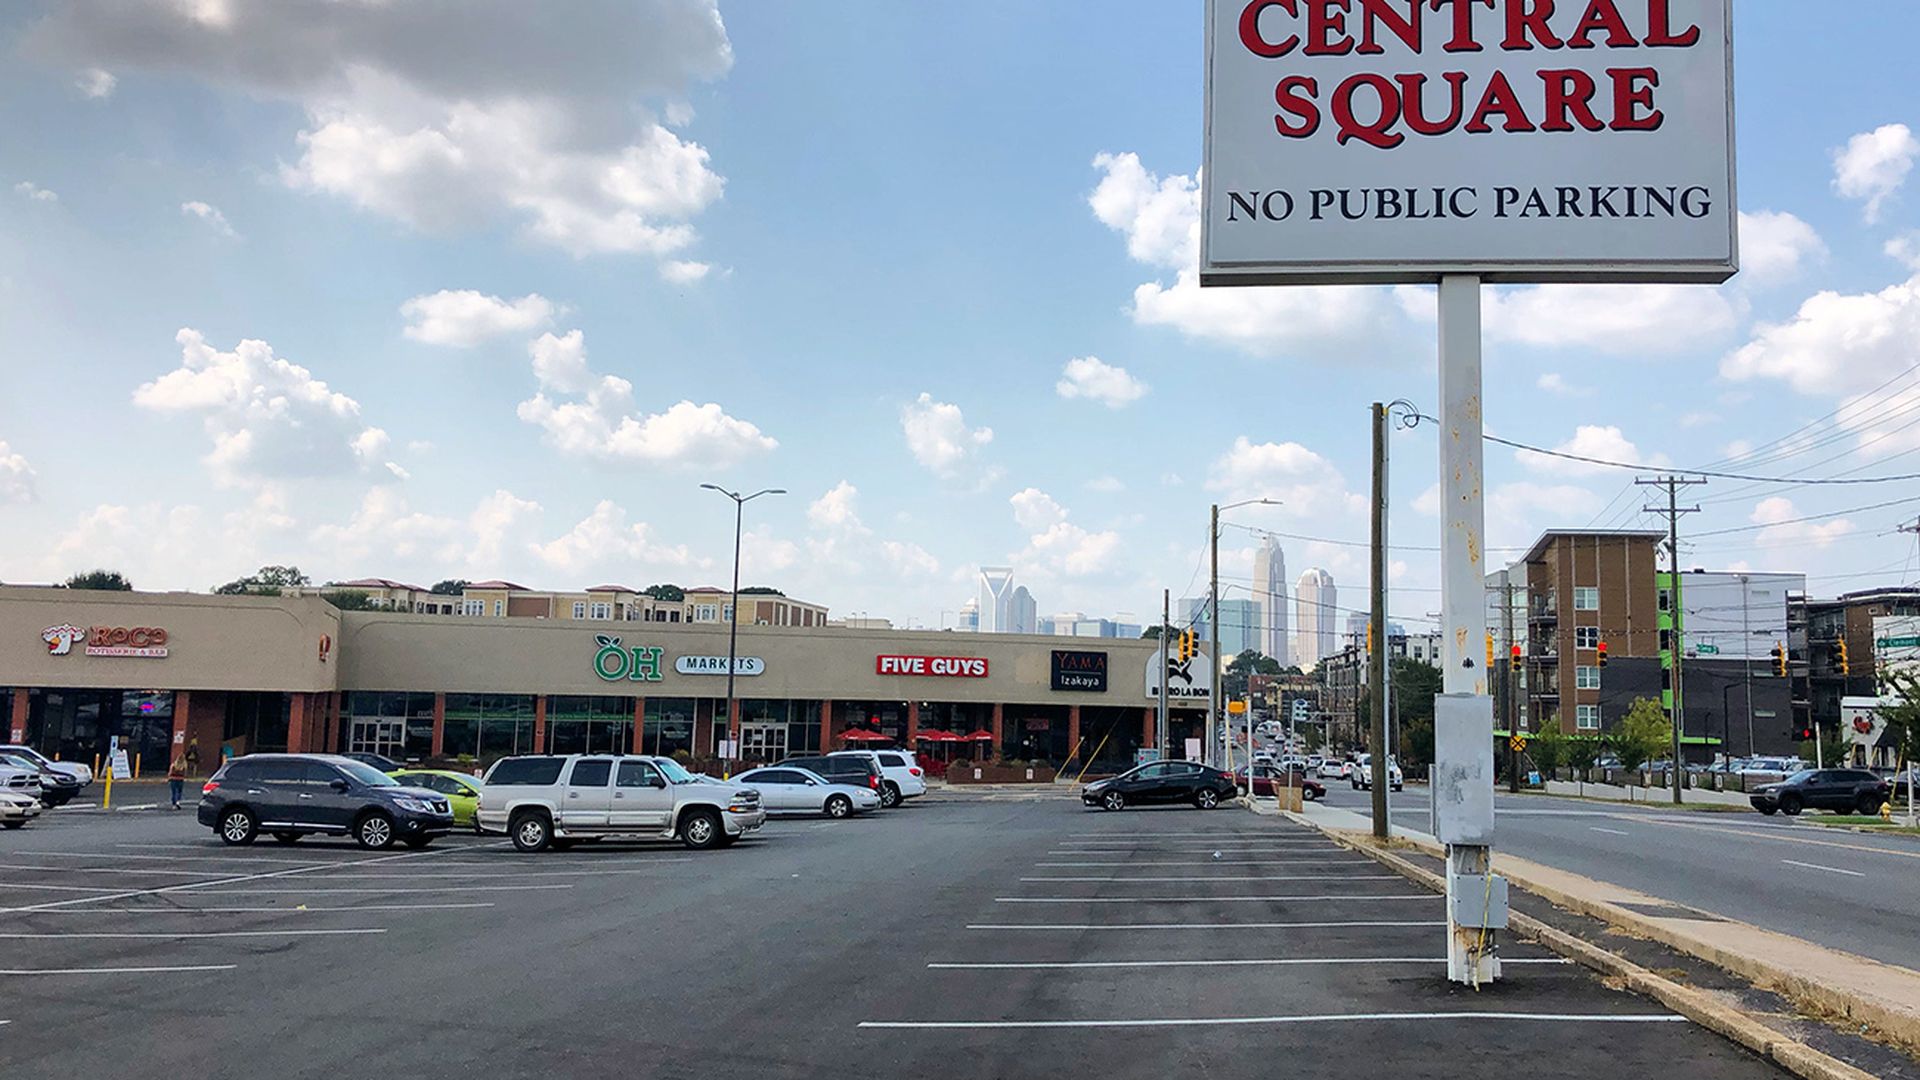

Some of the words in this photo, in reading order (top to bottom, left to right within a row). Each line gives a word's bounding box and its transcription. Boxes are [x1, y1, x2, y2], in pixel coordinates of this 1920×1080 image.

[1238, 0, 1700, 58] CENTRAL
[1274, 66, 1666, 149] SQUARE
[1227, 190, 1294, 223] NO
[1309, 187, 1478, 221] PUBLIC
[1493, 185, 1712, 220] PARKING
[686, 656, 754, 670] MARKTS
[881, 657, 926, 673] FIVE
[931, 658, 986, 675] GUYS
[1056, 653, 1105, 669] YAMA
[1061, 675, 1100, 687] Izakaya
[1152, 686, 1180, 697] BRO
[1181, 687, 1192, 697] LA
